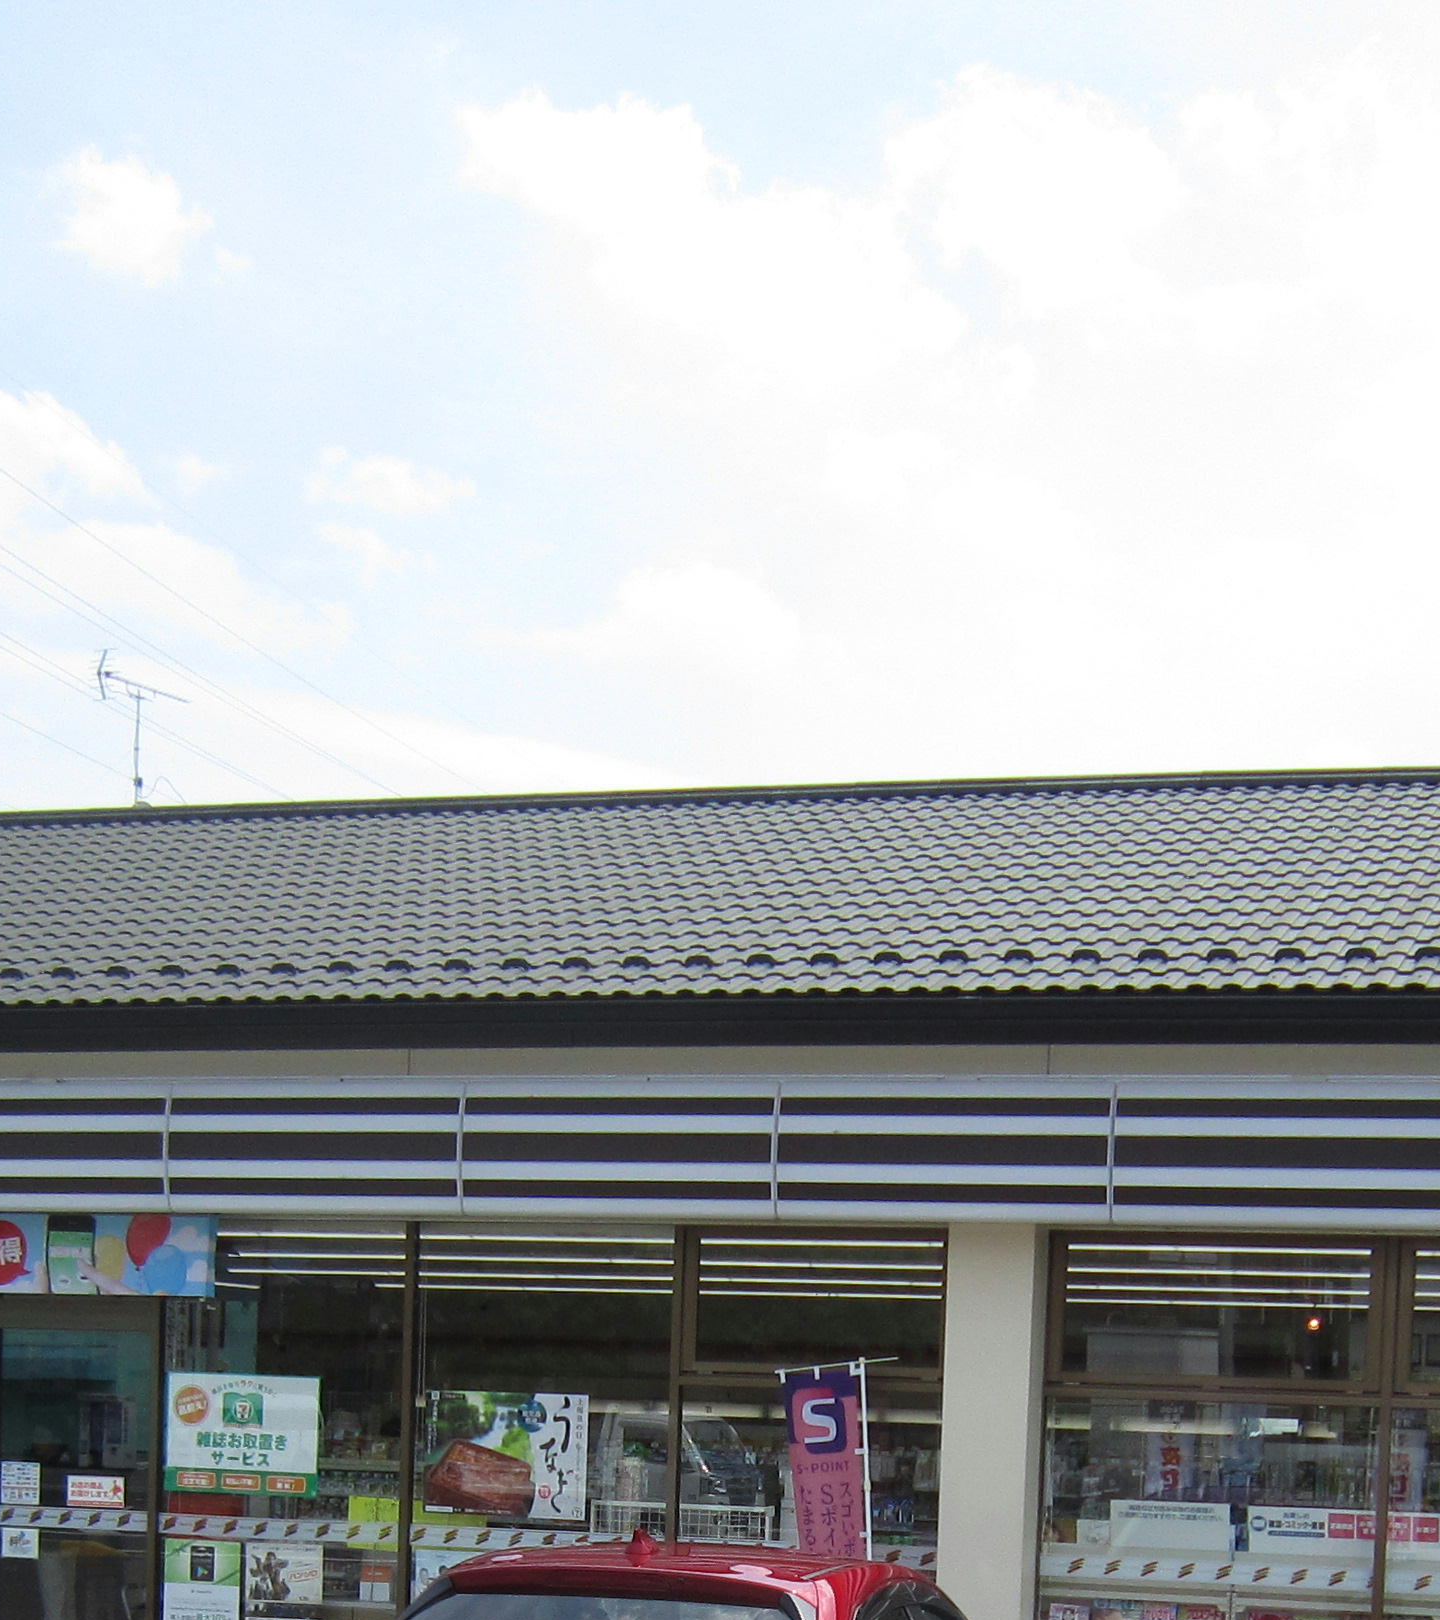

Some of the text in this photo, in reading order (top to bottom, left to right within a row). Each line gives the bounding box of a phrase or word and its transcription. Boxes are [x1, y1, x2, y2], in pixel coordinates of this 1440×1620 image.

[802, 1398, 837, 1444] S
[196, 1431, 287, 1451] 雑誌お取置き
[211, 1451, 270, 1466] サービス
[797, 1461, 850, 1474] S-POINT
[800, 1485, 816, 1552] たまる
[821, 1484, 837, 1553] Sポイ
